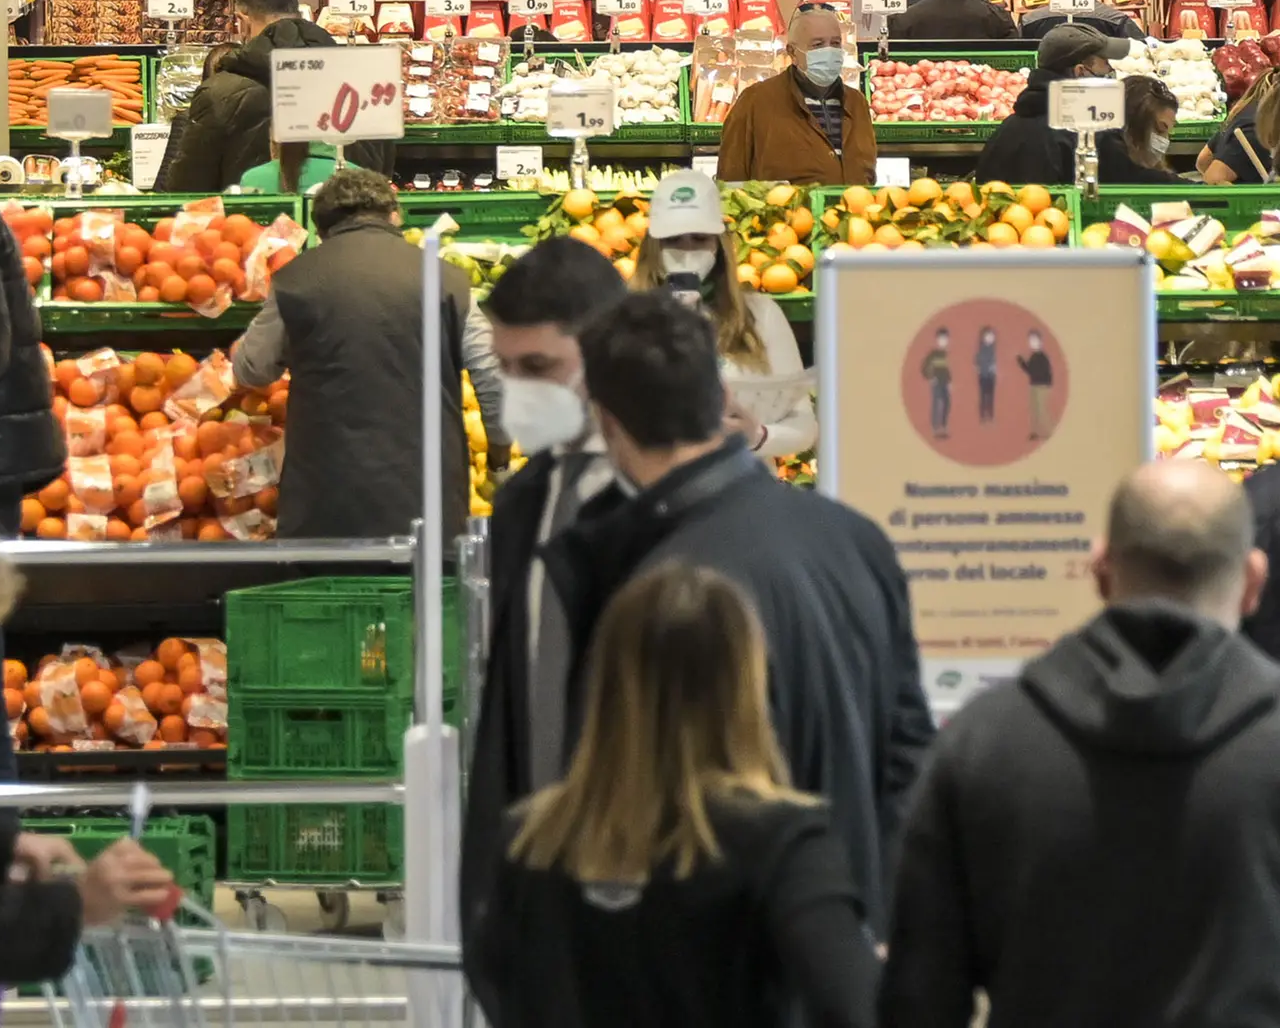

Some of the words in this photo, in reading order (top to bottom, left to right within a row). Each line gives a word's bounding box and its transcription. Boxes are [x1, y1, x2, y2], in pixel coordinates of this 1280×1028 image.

[168, 2, 188, 14] 2,49
[349, 0, 367, 11] 1,79
[444, 0, 464, 11] 3,49
[276, 61, 297, 71] LIME
[331, 82, 396, 133] 0,99
[1087, 105, 1115, 122] 1,99
[576, 112, 604, 128] 1,99
[516, 164, 537, 176] 2,99
[984, 478, 1069, 498] massimo
[893, 535, 1091, 557] ontemporaneamente
